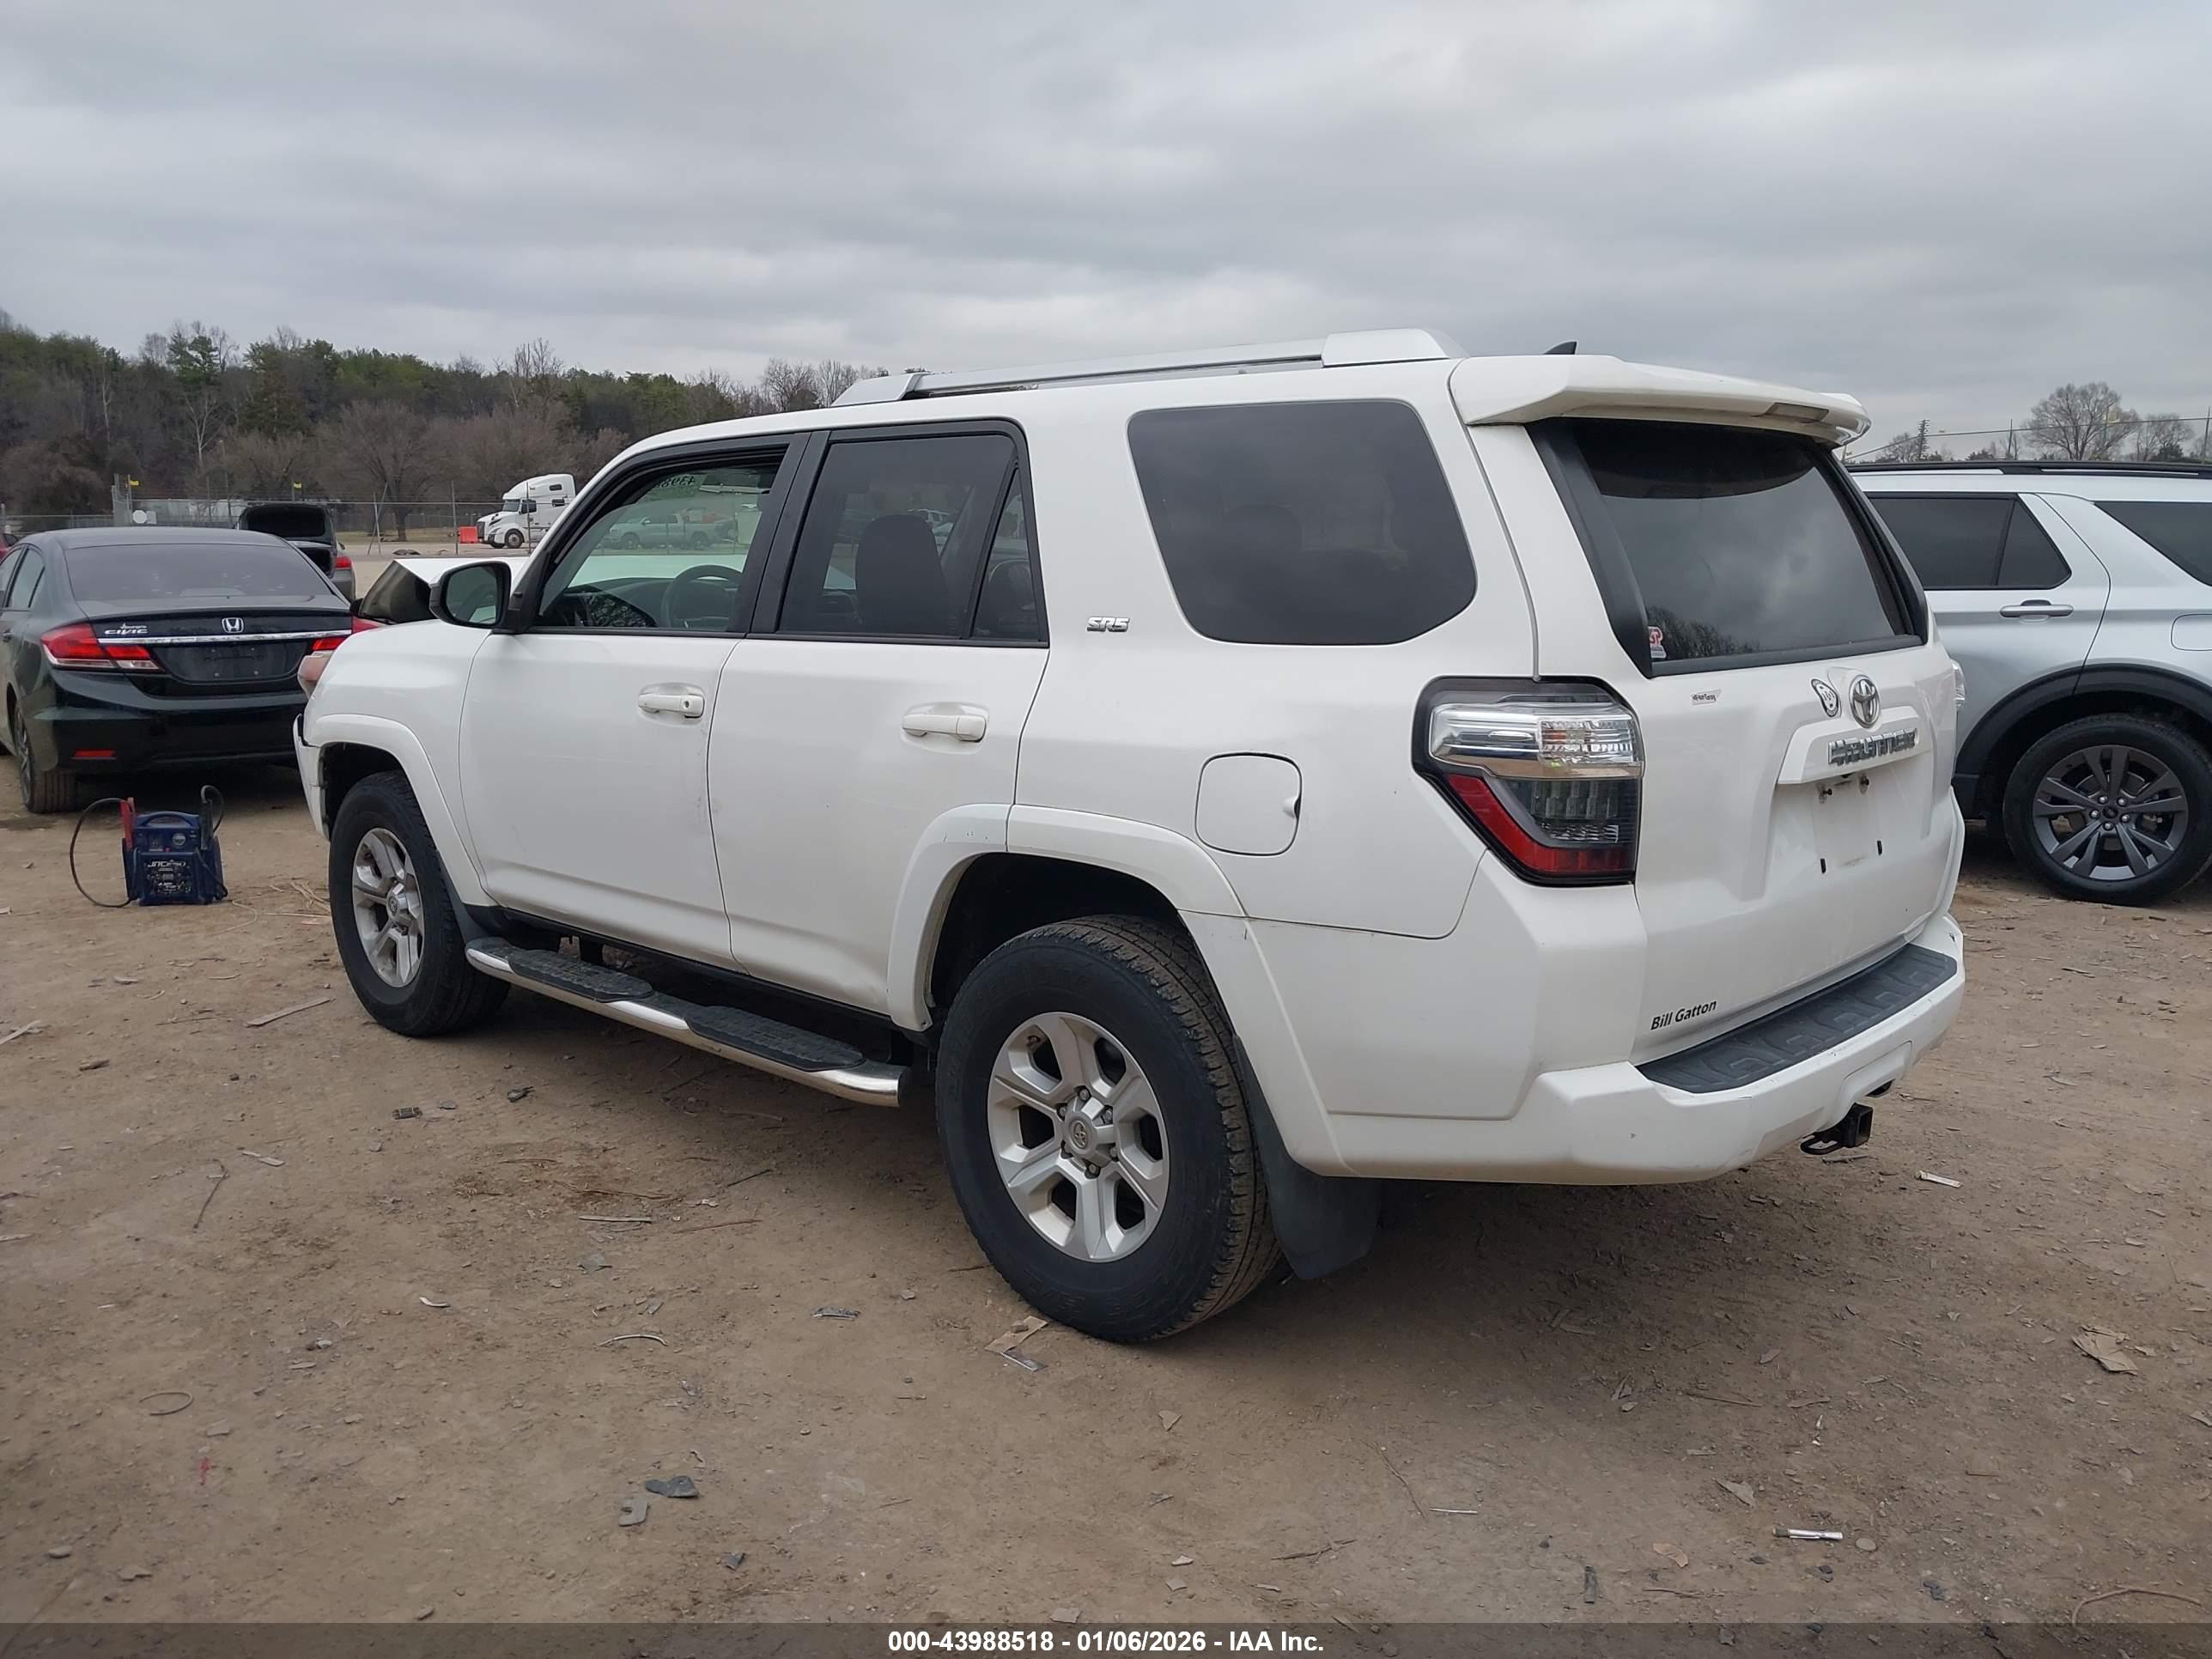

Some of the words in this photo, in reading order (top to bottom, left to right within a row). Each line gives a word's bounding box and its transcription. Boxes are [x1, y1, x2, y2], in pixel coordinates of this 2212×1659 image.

[1086, 616, 1130, 633] SR5
[1650, 1012, 1674, 1030] Bill
[1674, 1000, 1717, 1023] Gatton
